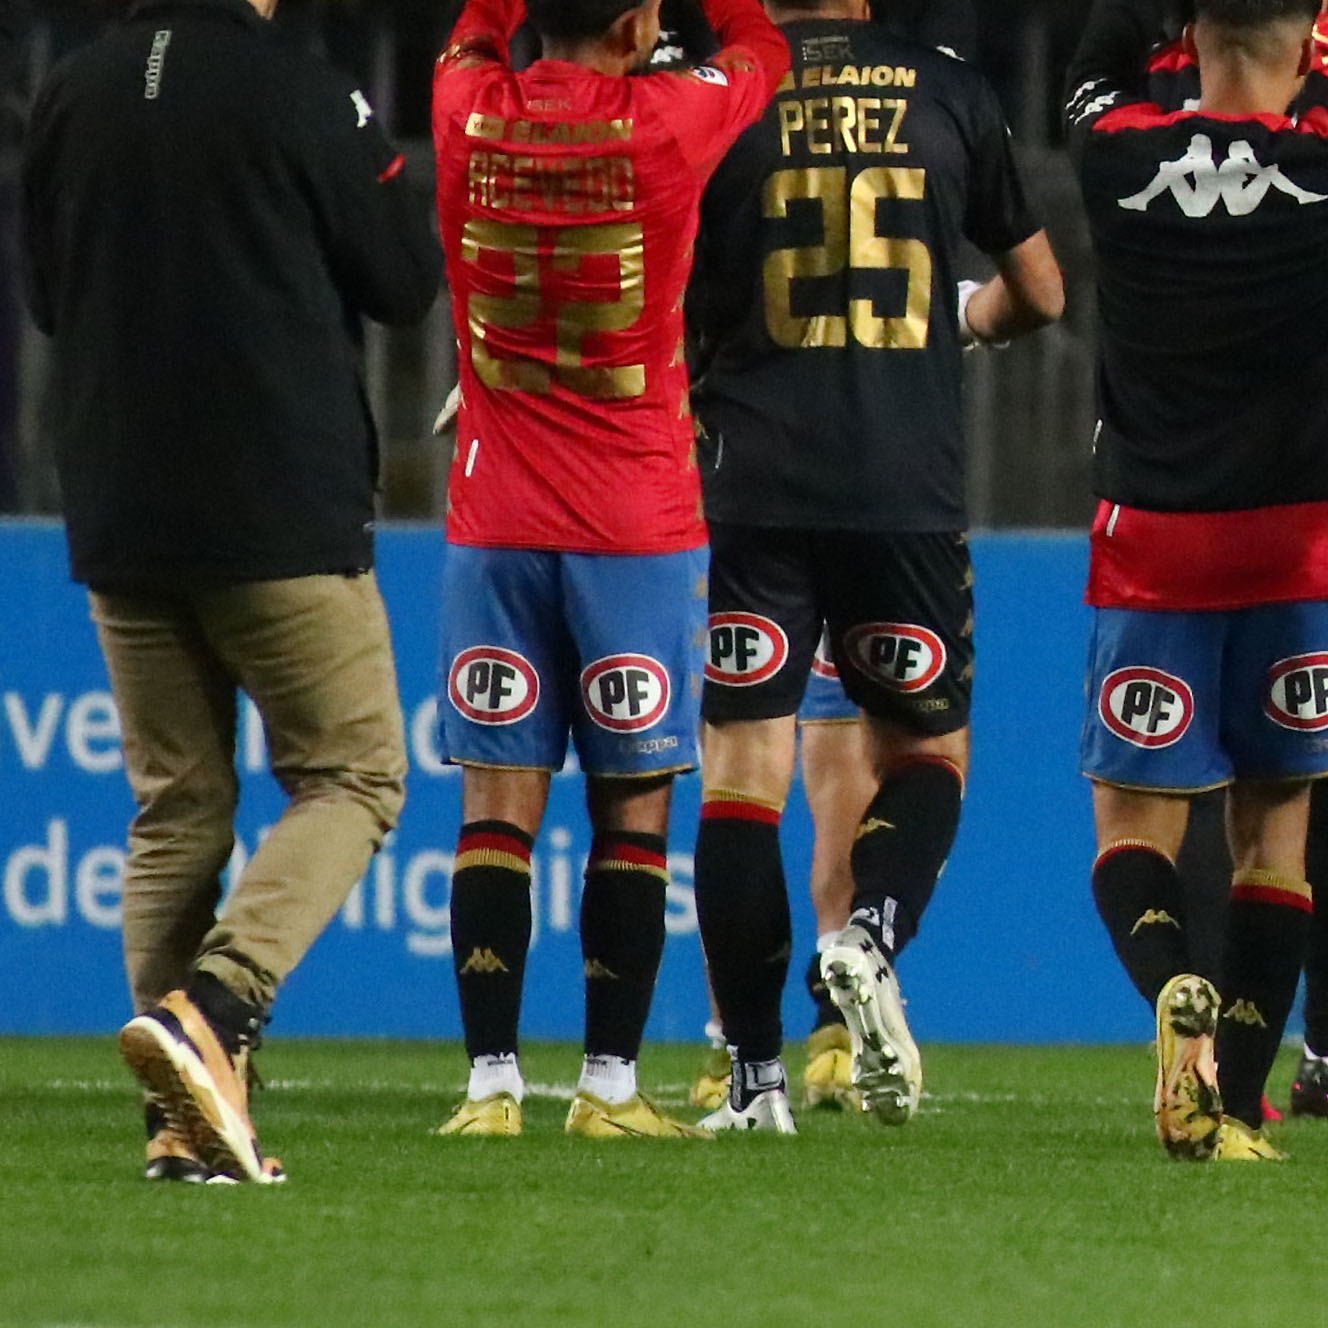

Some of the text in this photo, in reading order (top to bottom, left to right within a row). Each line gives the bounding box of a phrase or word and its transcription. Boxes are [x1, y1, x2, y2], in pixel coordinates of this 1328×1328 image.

[801, 65, 917, 88] ELAION
[778, 96, 909, 157] PEREZ
[762, 166, 932, 350] 25
[461, 221, 647, 397] 22
[709, 626, 759, 671] PF
[869, 635, 922, 679] PF
[466, 661, 515, 709] PF
[599, 672, 650, 716] PF
[1121, 681, 1175, 733] PF
